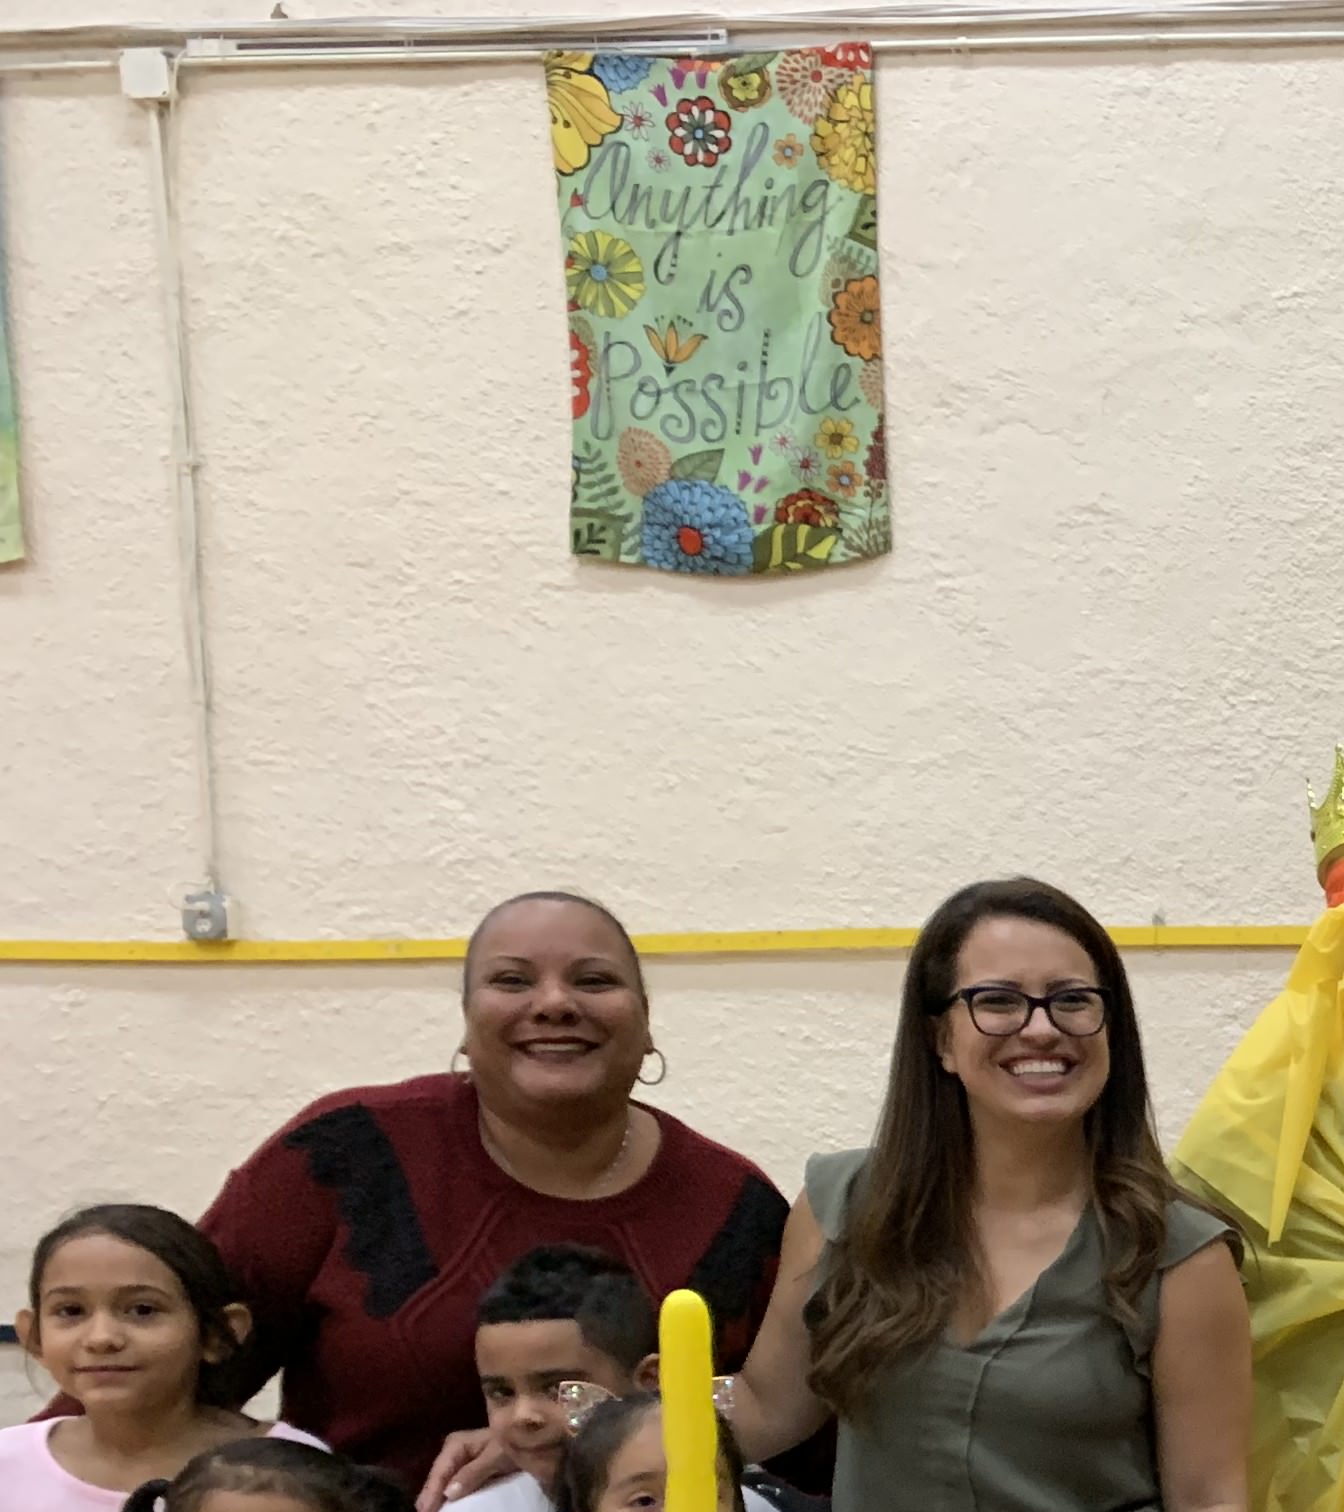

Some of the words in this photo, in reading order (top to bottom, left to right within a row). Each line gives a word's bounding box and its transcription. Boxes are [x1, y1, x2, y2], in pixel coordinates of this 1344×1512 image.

[582, 121, 836, 286] Anything
[697, 252, 752, 332] is
[590, 312, 860, 444] Possible
